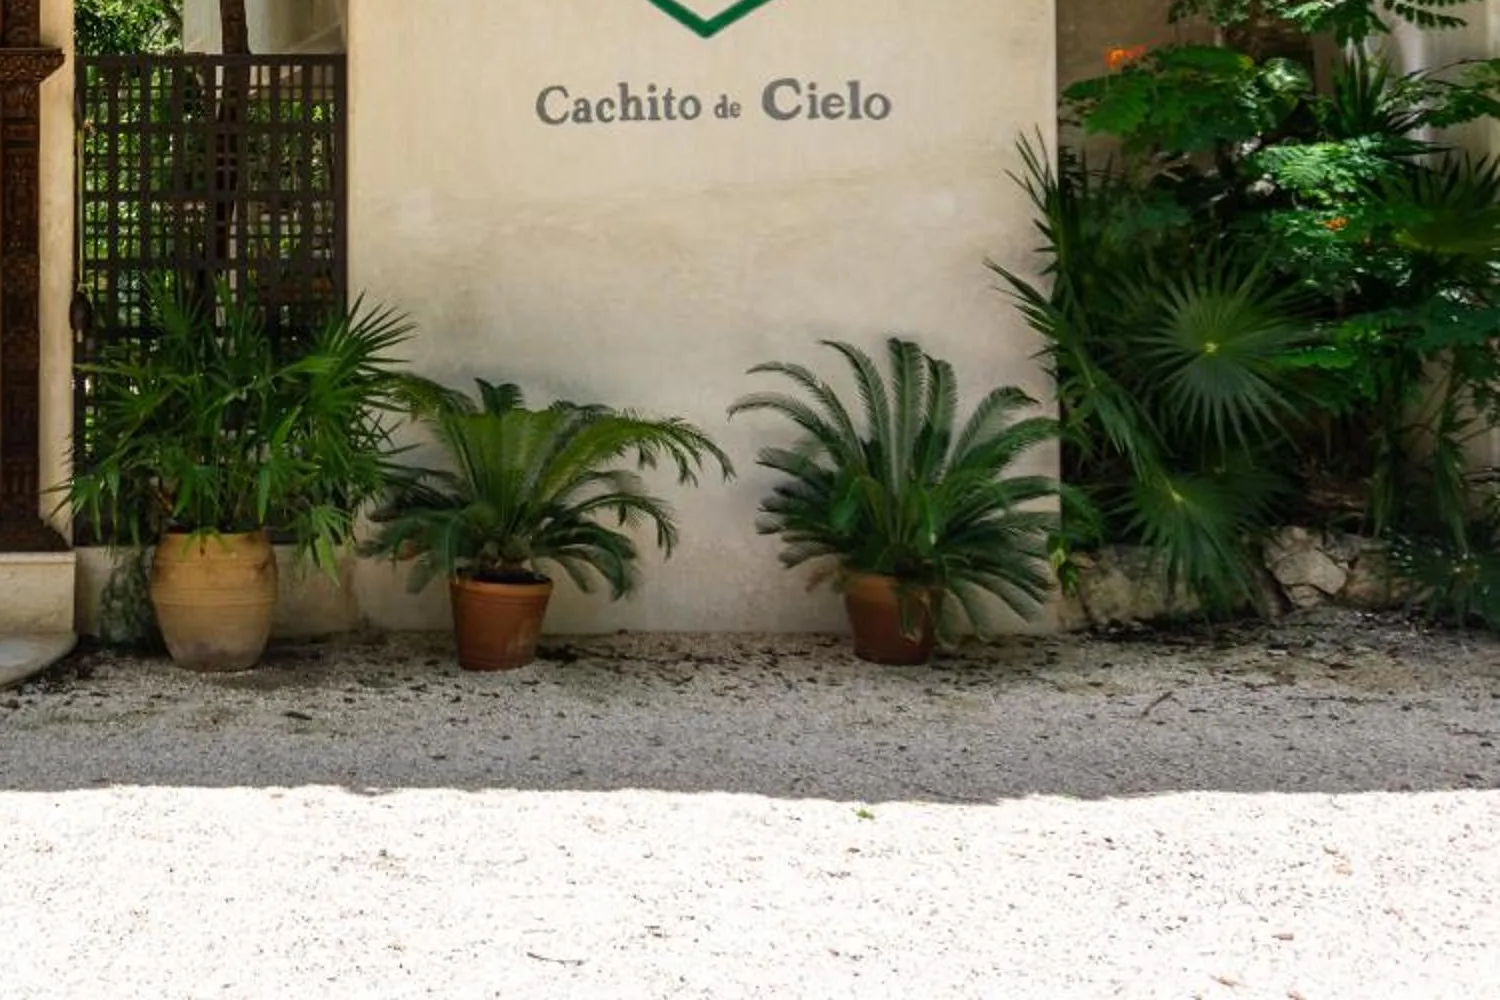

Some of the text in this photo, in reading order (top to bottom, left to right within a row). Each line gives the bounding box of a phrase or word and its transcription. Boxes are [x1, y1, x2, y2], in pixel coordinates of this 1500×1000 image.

[535, 77, 892, 125] Cachito de Cielo
